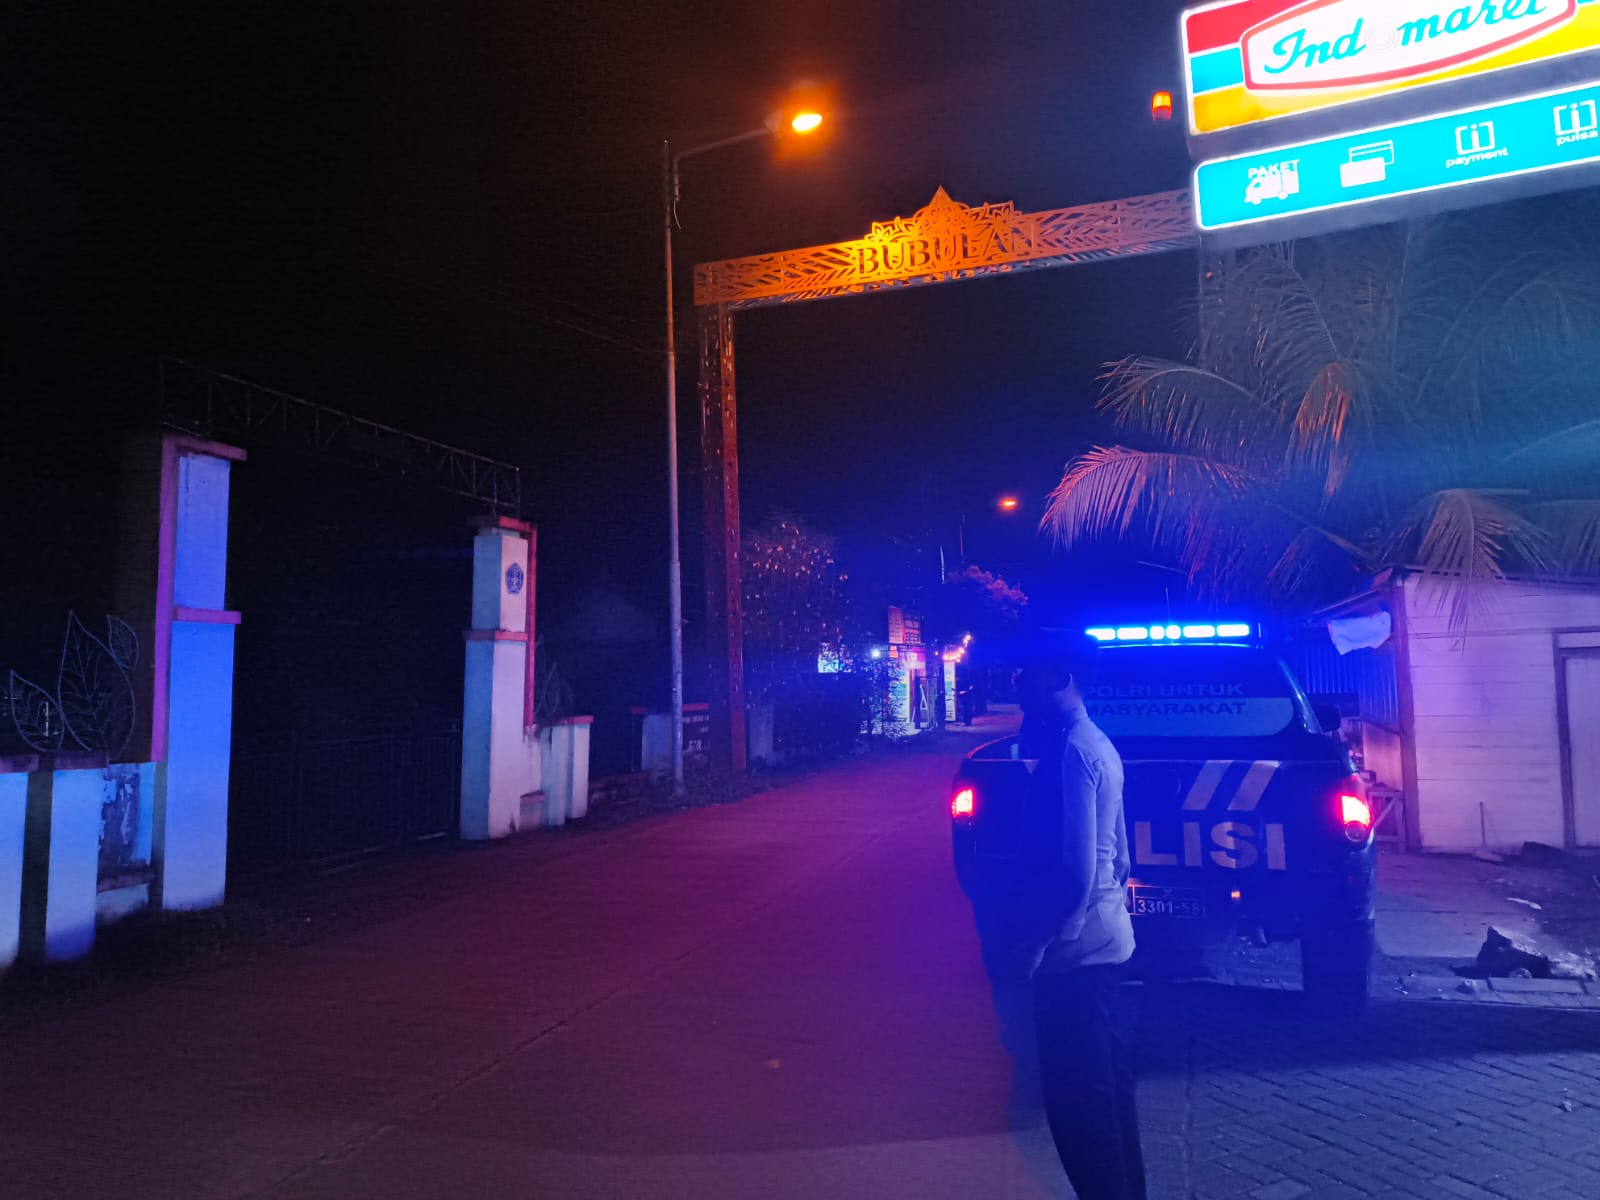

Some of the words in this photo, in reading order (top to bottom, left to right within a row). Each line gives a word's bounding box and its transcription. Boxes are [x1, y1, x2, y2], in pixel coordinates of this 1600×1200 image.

[1555, 129, 1599, 147] pulsa
[1445, 147, 1509, 168] payment
[1247, 159, 1301, 179] PAKET
[857, 225, 1036, 274] BUBULAN
[1086, 684, 1152, 698] POLRI
[1160, 682, 1244, 697] UNTUK
[1134, 820, 1287, 871] LISI
